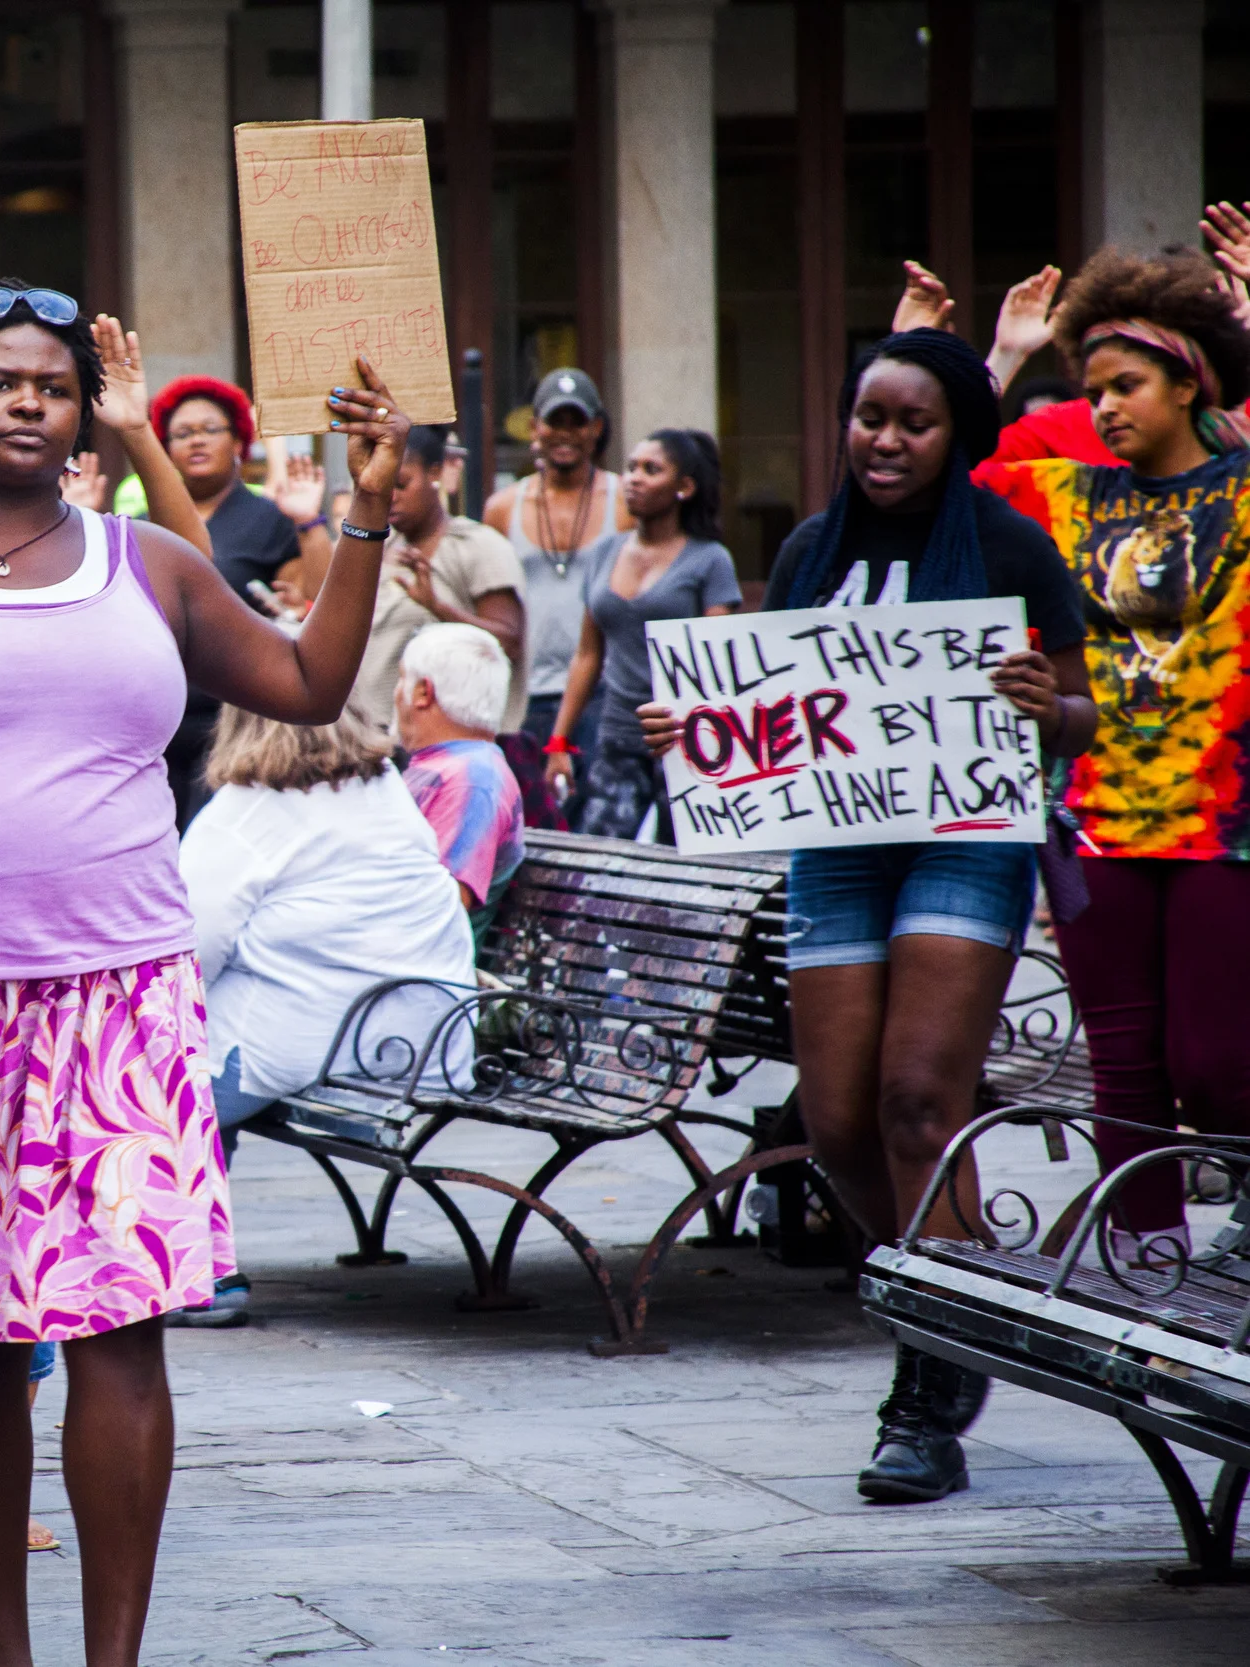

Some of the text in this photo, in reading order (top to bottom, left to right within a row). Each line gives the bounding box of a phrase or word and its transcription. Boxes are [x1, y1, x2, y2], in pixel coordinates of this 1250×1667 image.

[314, 128, 407, 193] ANGRY
[646, 621, 1012, 700] WILL THIS BE
[679, 687, 1034, 783] OVER BY THE
[669, 784, 765, 840] TIME
[768, 779, 814, 822] I
[810, 766, 919, 828] HAVE
[928, 760, 962, 820] A
